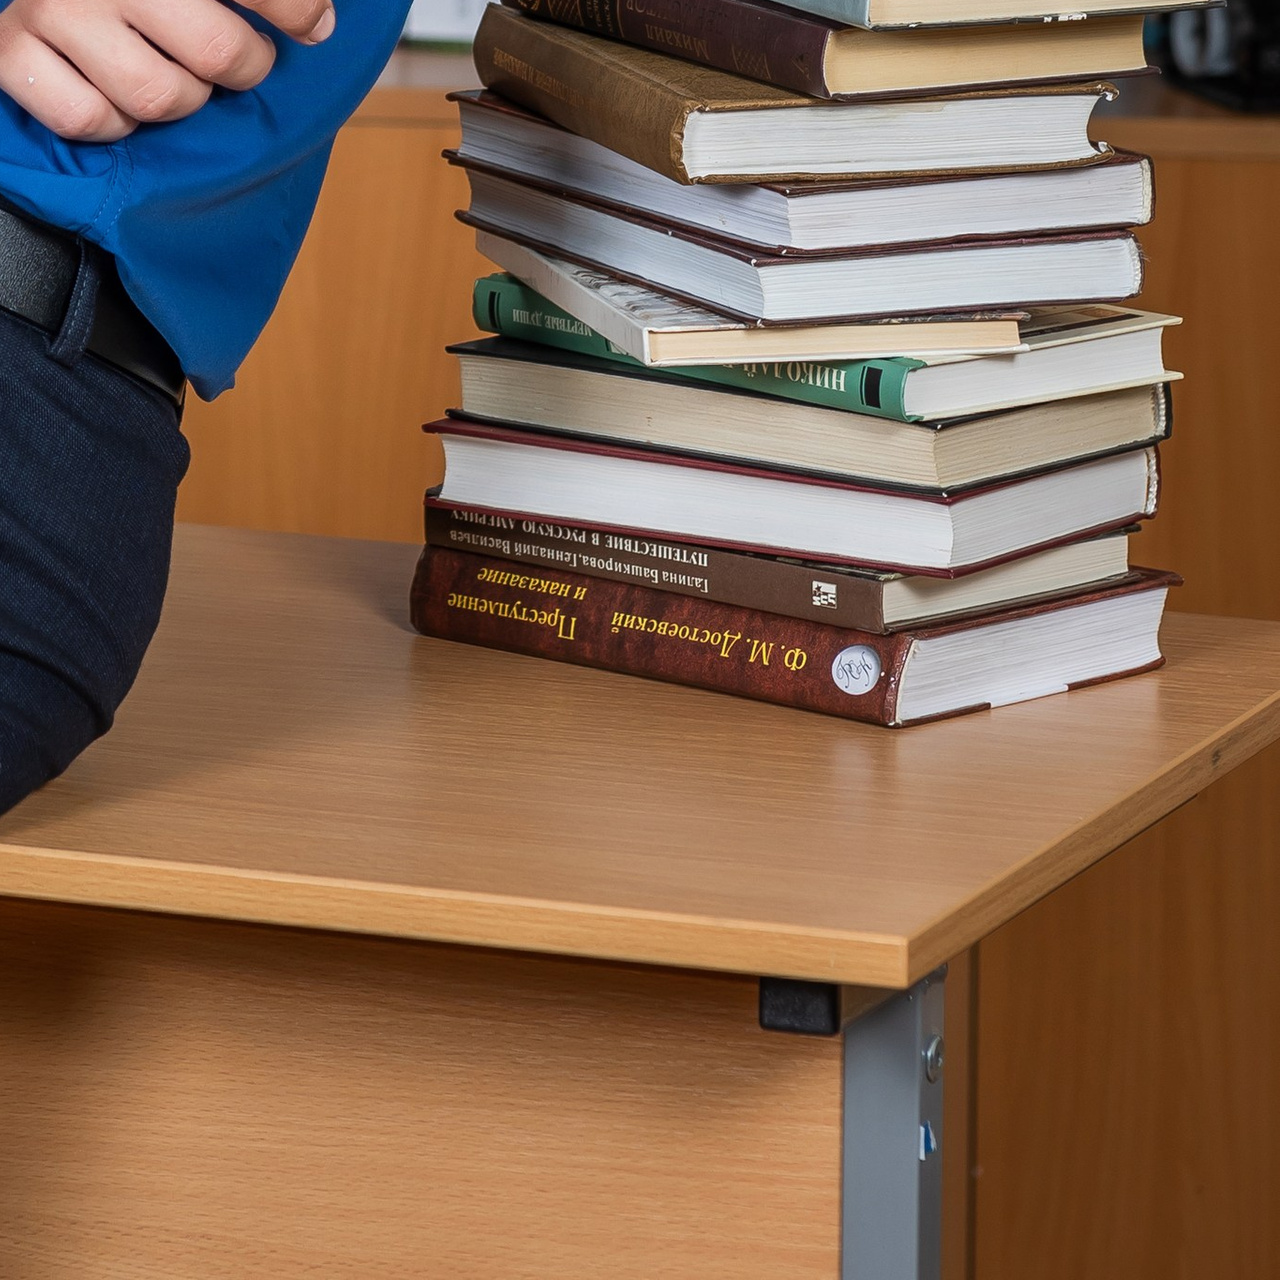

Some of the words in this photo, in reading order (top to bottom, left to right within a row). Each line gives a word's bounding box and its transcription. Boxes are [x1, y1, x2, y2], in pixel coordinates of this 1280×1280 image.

[645, 23, 710, 60] Михаил
[512, 308, 542, 327] ДУШИ
[545, 314, 592, 337] МЕРТВЫЕ
[450, 530, 511, 554] Васильев
[522, 521, 586, 544] РУССКУЮ
[591, 533, 599, 546] В
[605, 534, 708, 567] ПУТЕШЕСТВИЕ
[477, 568, 571, 599] наказание
[573, 586, 587, 601] и
[662, 570, 709, 593] Галина
[447, 593, 577, 640] Преступление
[611, 612, 741, 657] Достоевский
[746, 638, 774, 666] М.
[780, 645, 807, 671] Ф.
